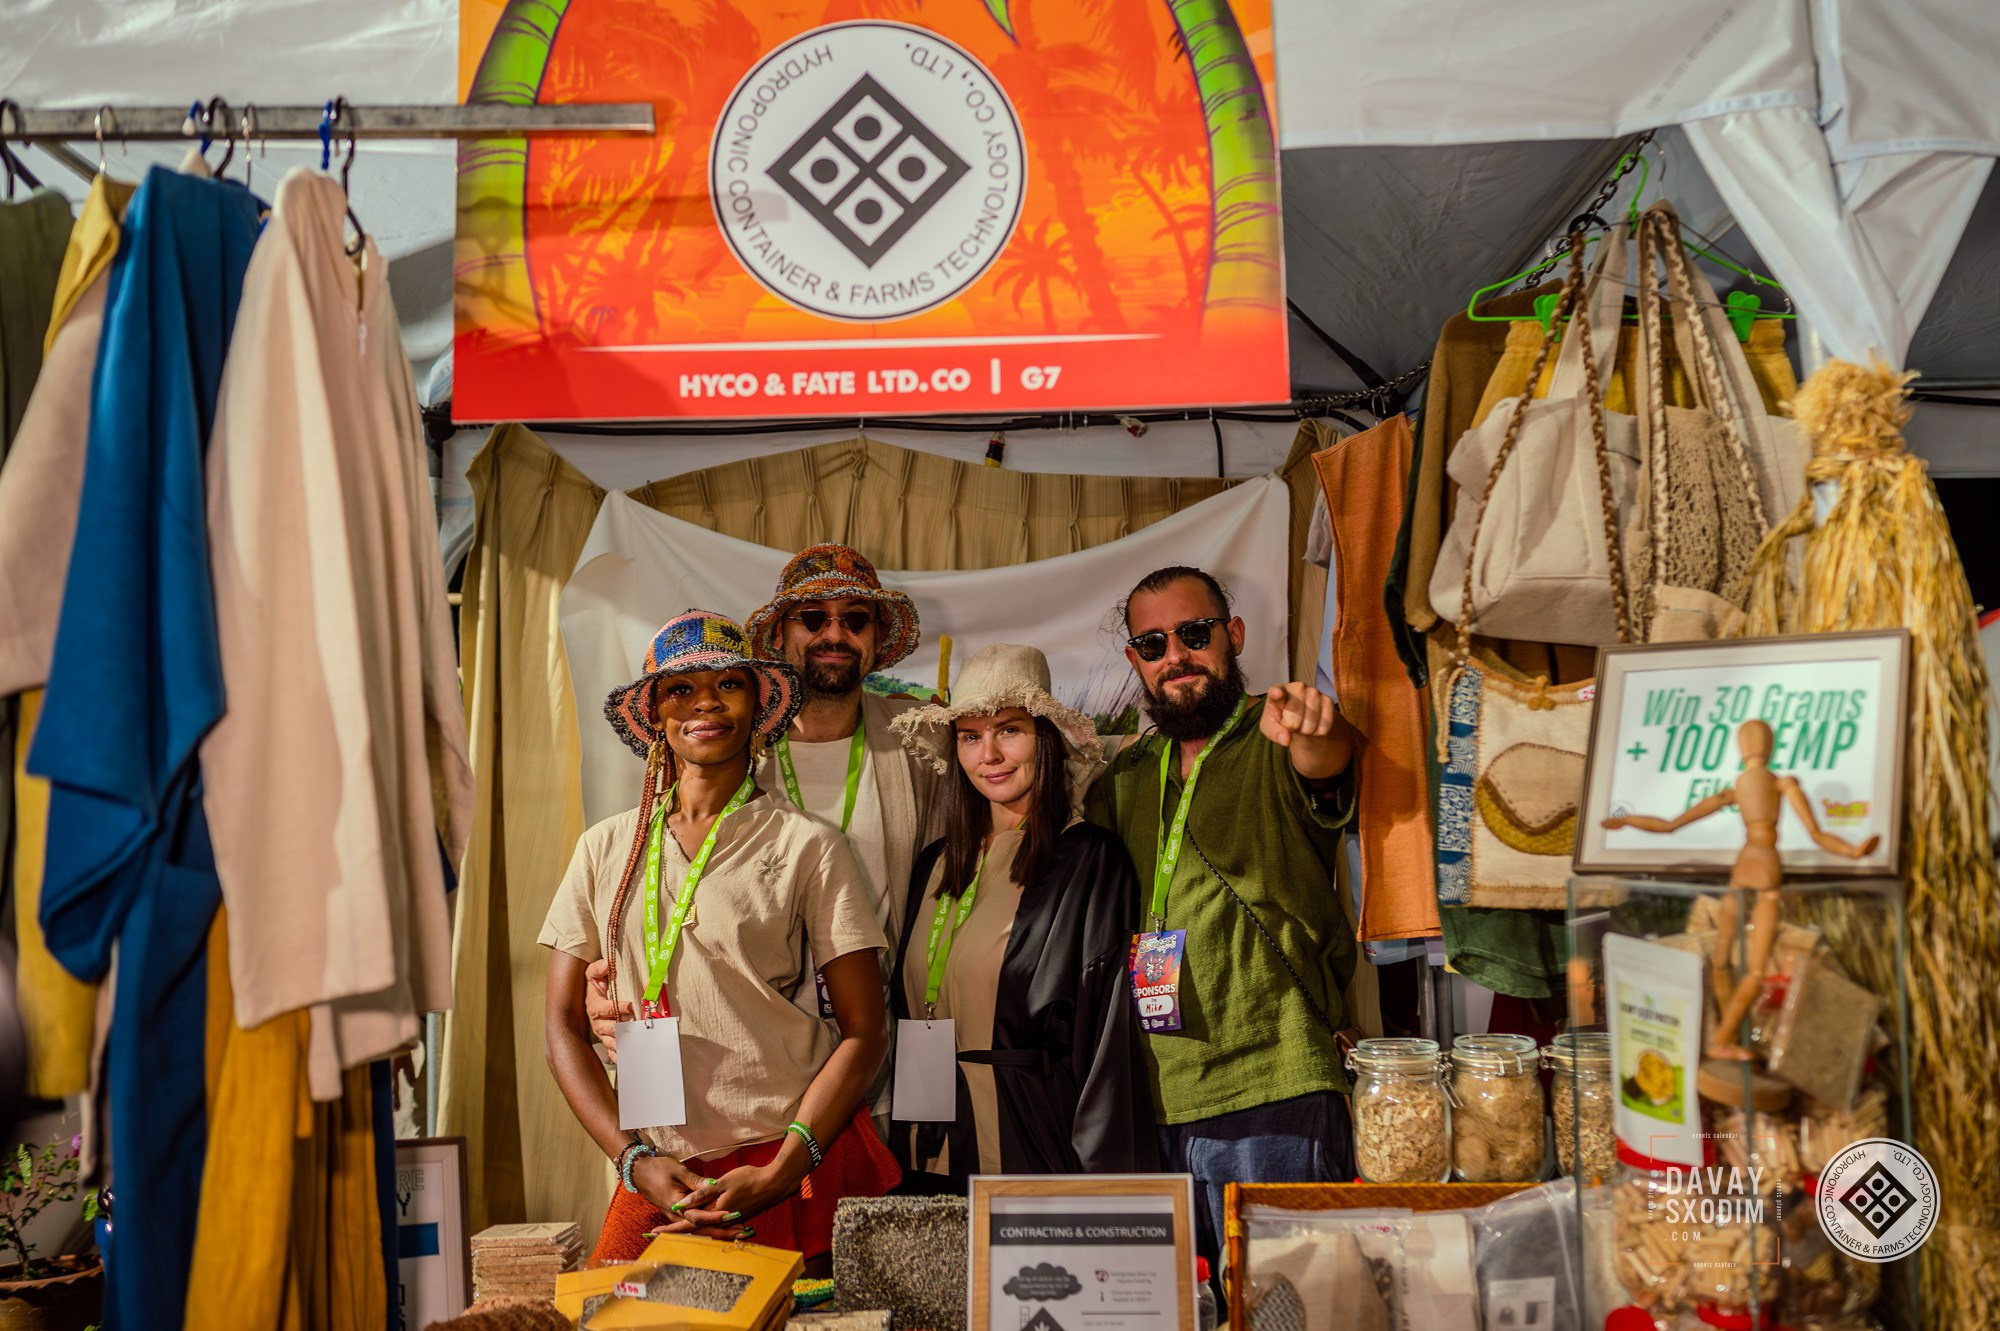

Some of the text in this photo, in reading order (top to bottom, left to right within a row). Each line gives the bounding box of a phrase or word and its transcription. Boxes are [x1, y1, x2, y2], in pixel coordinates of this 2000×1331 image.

[905, 42, 955, 81] LTD.
[728, 44, 834, 174] HYDROPONIC
[934, 129, 1010, 280] TECHNOLOGY
[728, 179, 822, 296] CONTAINER
[825, 281, 840, 302] &
[849, 271, 935, 306] FARMS
[679, 365, 1062, 398] HYCO & FATE LTD.CO G7
[1643, 683, 1868, 728] Win 30 Grams
[1659, 723, 1730, 773] 100
[1738, 720, 1860, 770] EMP
[1133, 983, 1176, 998] SPONSORS
[397, 1169, 425, 1192] RE
[1000, 1225, 1167, 1238] CONTRACTING & CONSTRUCTION
[617, 1282, 639, 1293] 1500
